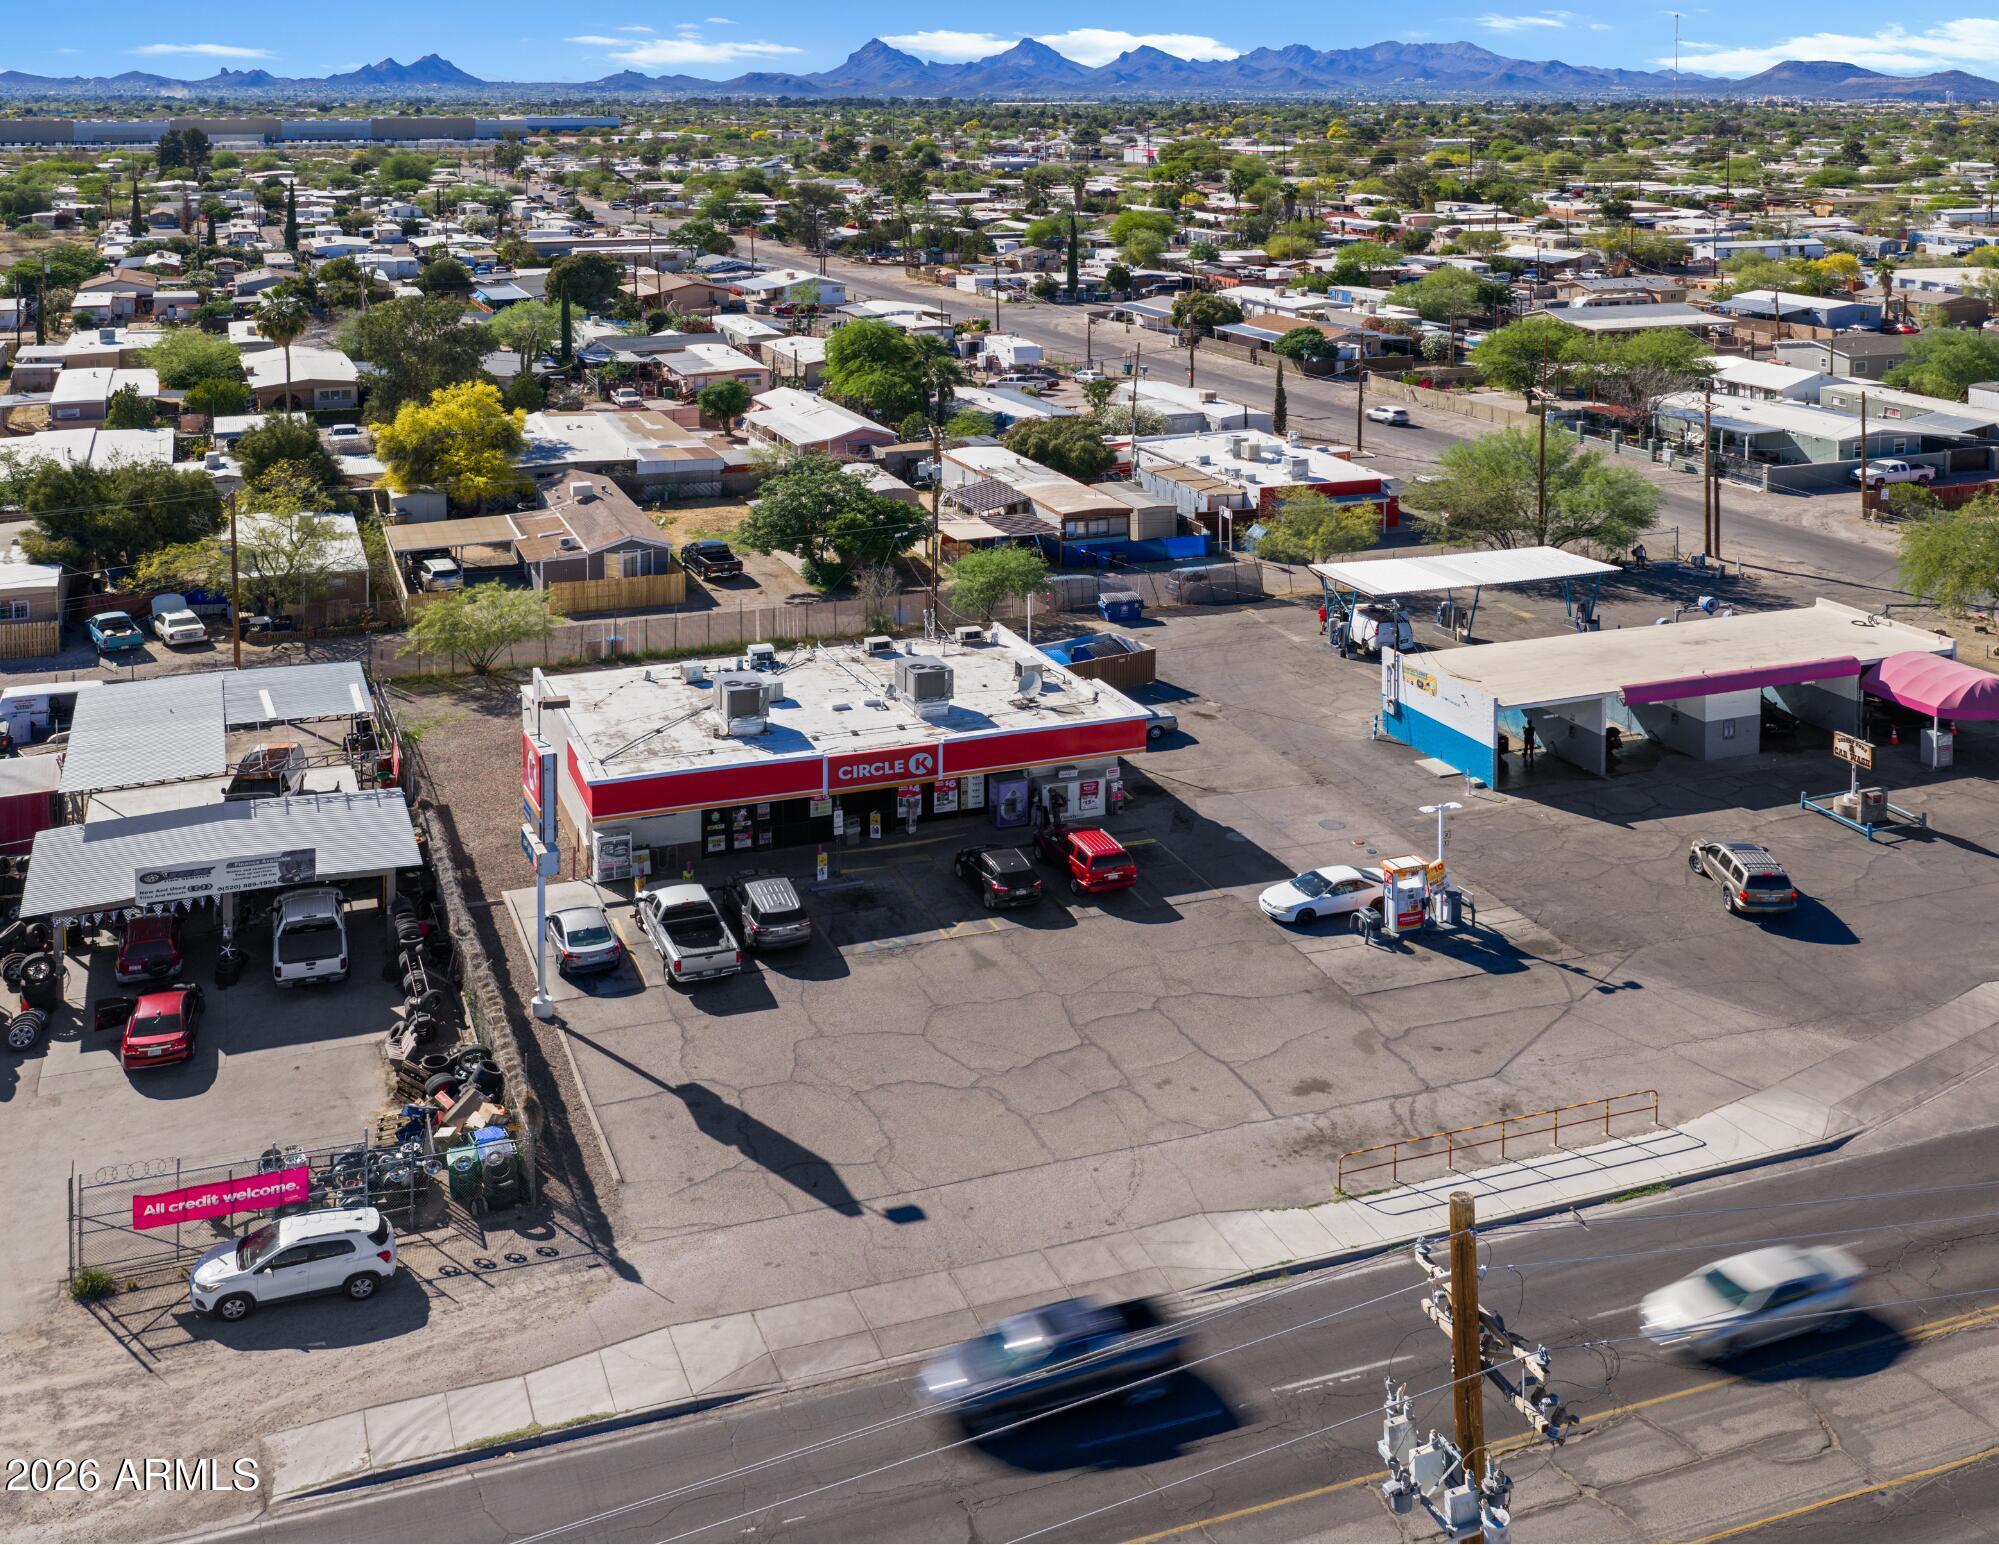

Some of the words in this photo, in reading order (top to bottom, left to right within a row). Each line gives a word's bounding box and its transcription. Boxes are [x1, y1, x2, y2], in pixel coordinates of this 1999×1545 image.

[838, 759, 904, 780] CIRCLE
[911, 754, 932, 774] K
[1835, 747, 1847, 759] CAR
[1850, 753, 1871, 767] WASH
[234, 860, 260, 868] Finance
[261, 856, 292, 866] Available
[156, 885, 168, 893] And
[170, 884, 187, 892] Used
[143, 1202, 166, 1216] All
[168, 1194, 219, 1213] credit
[222, 1182, 300, 1202] welcome.
